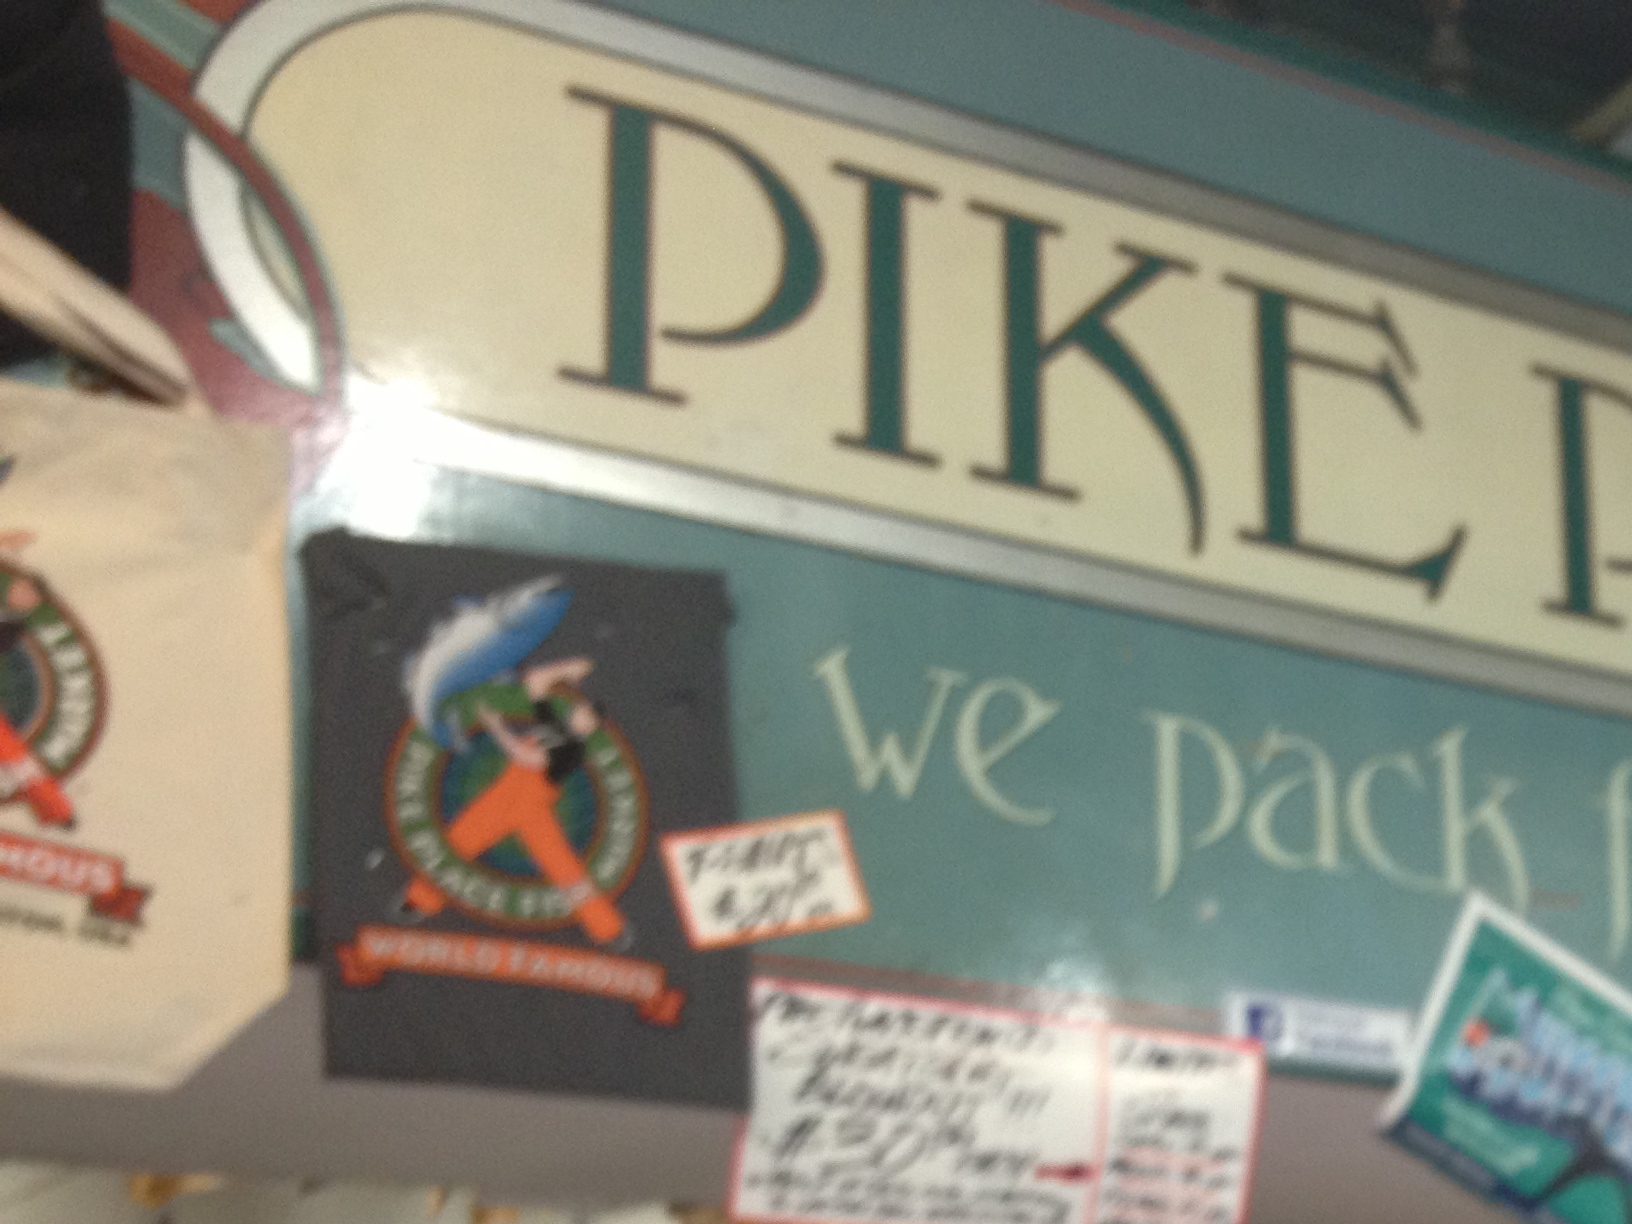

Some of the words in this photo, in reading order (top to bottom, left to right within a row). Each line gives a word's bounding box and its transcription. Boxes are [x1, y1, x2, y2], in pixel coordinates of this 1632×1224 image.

[556, 82, 1468, 603] PIKE
[811, 642, 1064, 827] We
[1141, 705, 1532, 918] pack
[369, 935, 502, 973] WORLD
[509, 945, 664, 994] FAMOUS
